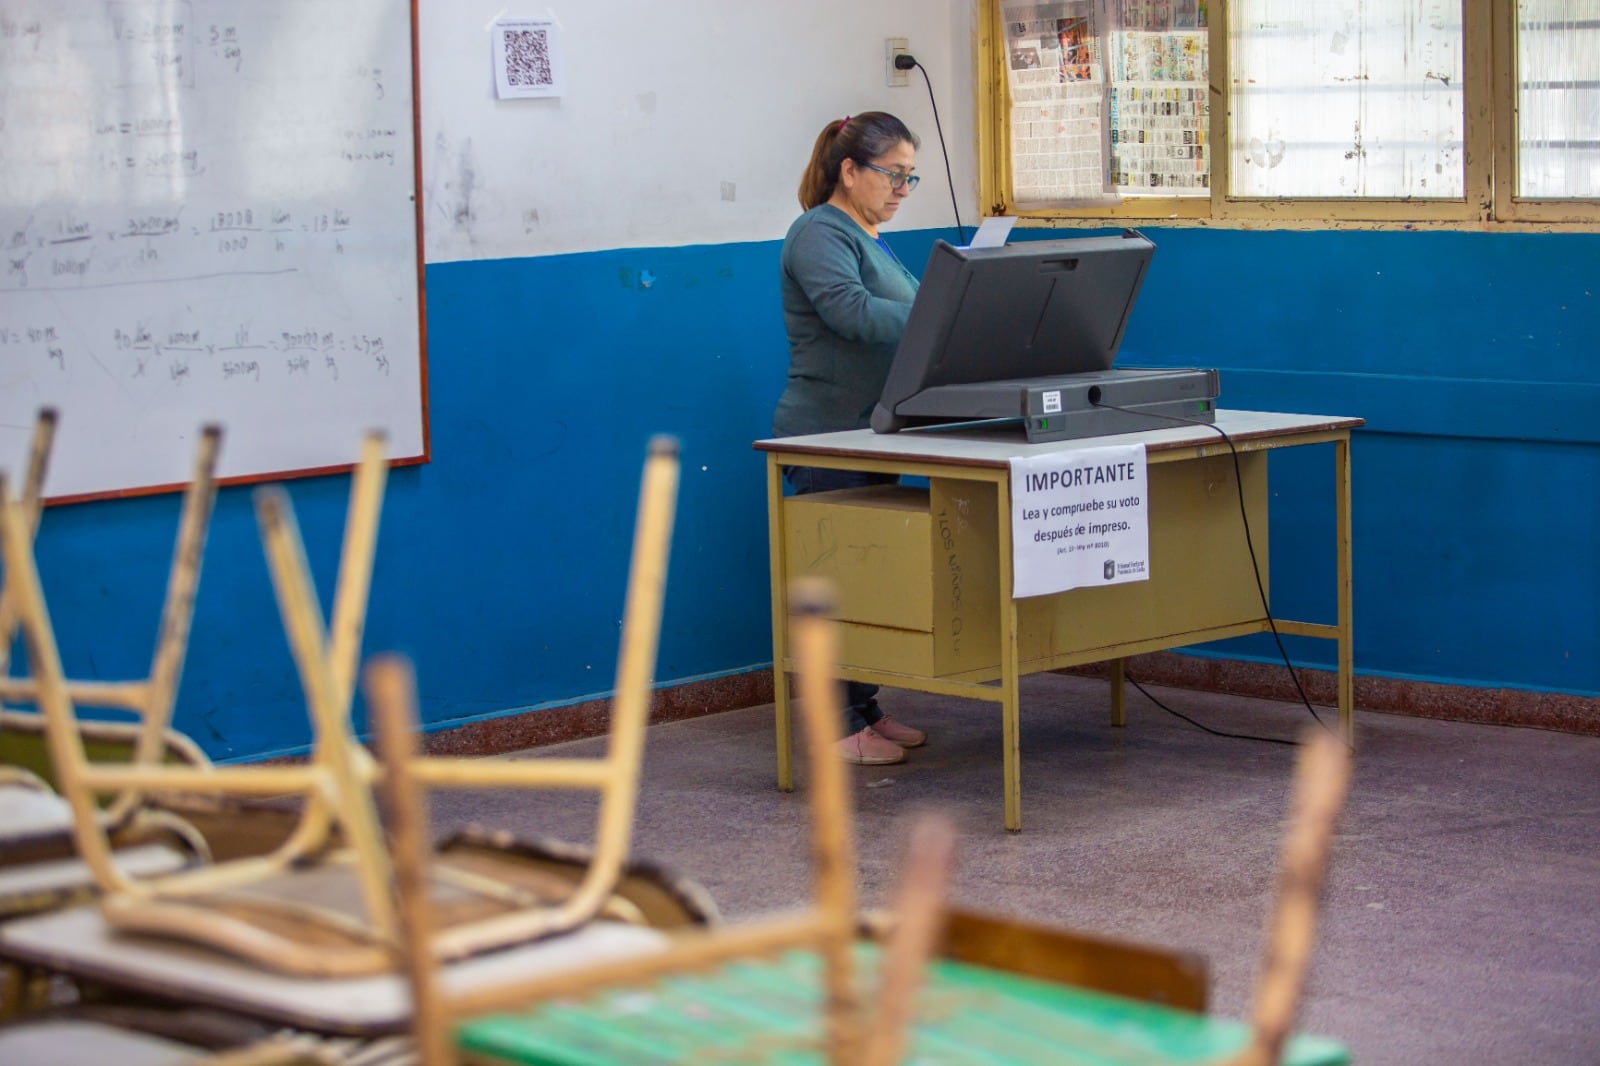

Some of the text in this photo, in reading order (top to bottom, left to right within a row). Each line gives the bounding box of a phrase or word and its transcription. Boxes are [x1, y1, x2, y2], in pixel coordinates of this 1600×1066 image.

[1026, 462, 1135, 493] IMPORTANTE
[1022, 496, 1140, 520] Lea y compruebe su voto
[938, 519, 954, 550] LOS
[1034, 521, 1131, 542] después de impreso.
